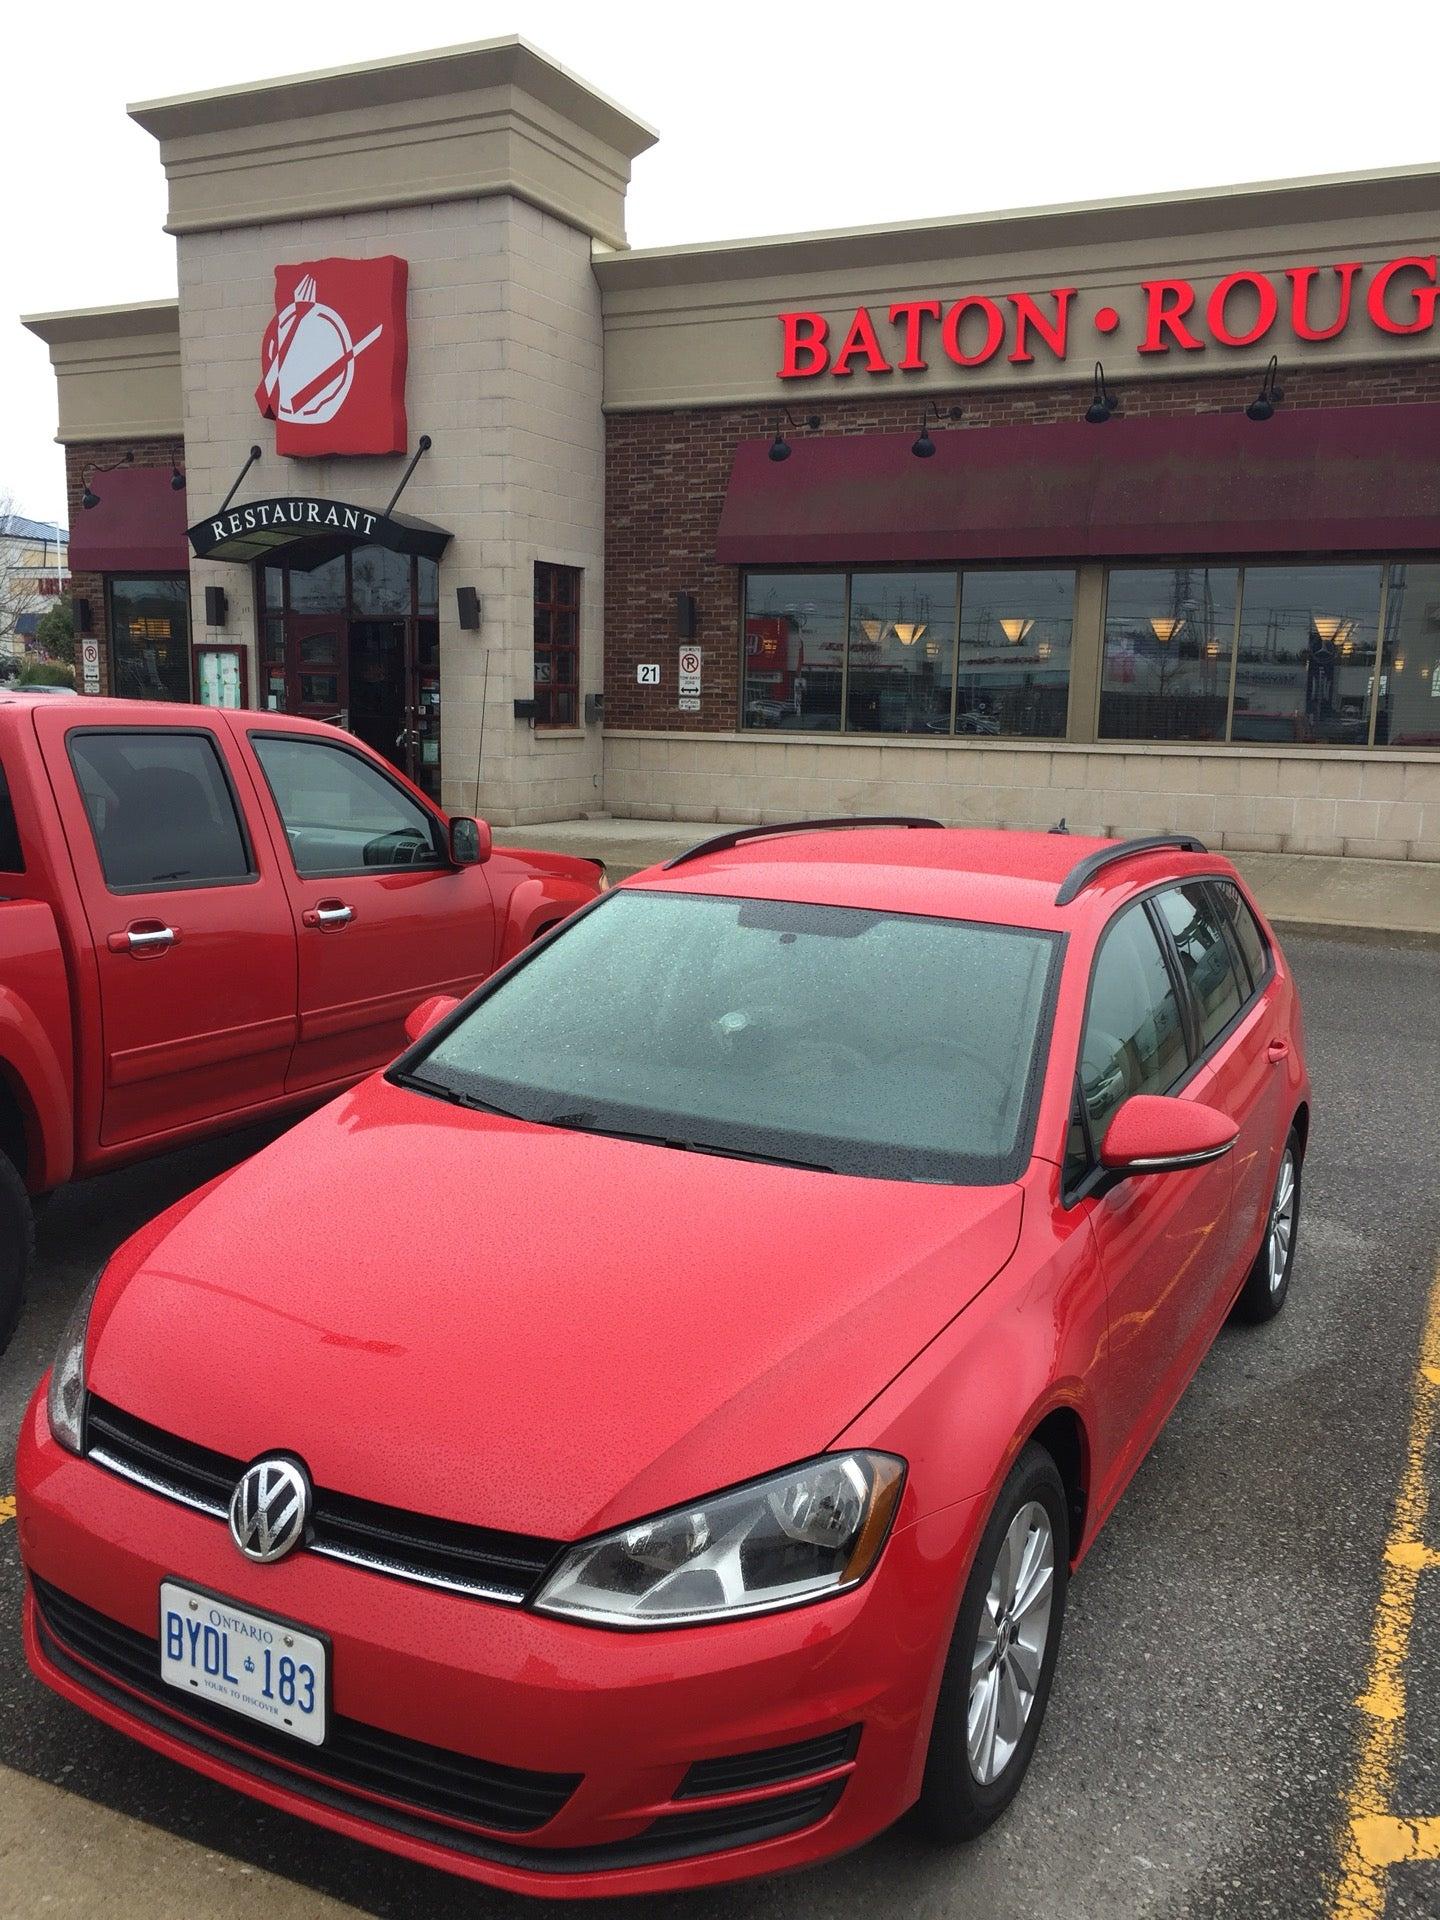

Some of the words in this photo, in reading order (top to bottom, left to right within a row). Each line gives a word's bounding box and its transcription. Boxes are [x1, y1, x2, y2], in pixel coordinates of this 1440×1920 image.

[777, 287, 1077, 380] BATON
[1136, 254, 1440, 354] ROUG
[211, 502, 377, 541] RESTAURANT
[641, 666, 657, 682] 21
[167, 1611, 239, 1685] BYDL
[262, 1648, 315, 1714] 183
[204, 1680, 228, 1693] YOURS
[230, 1690, 241, 1700] TO
[242, 1694, 279, 1715] DISCOVER
